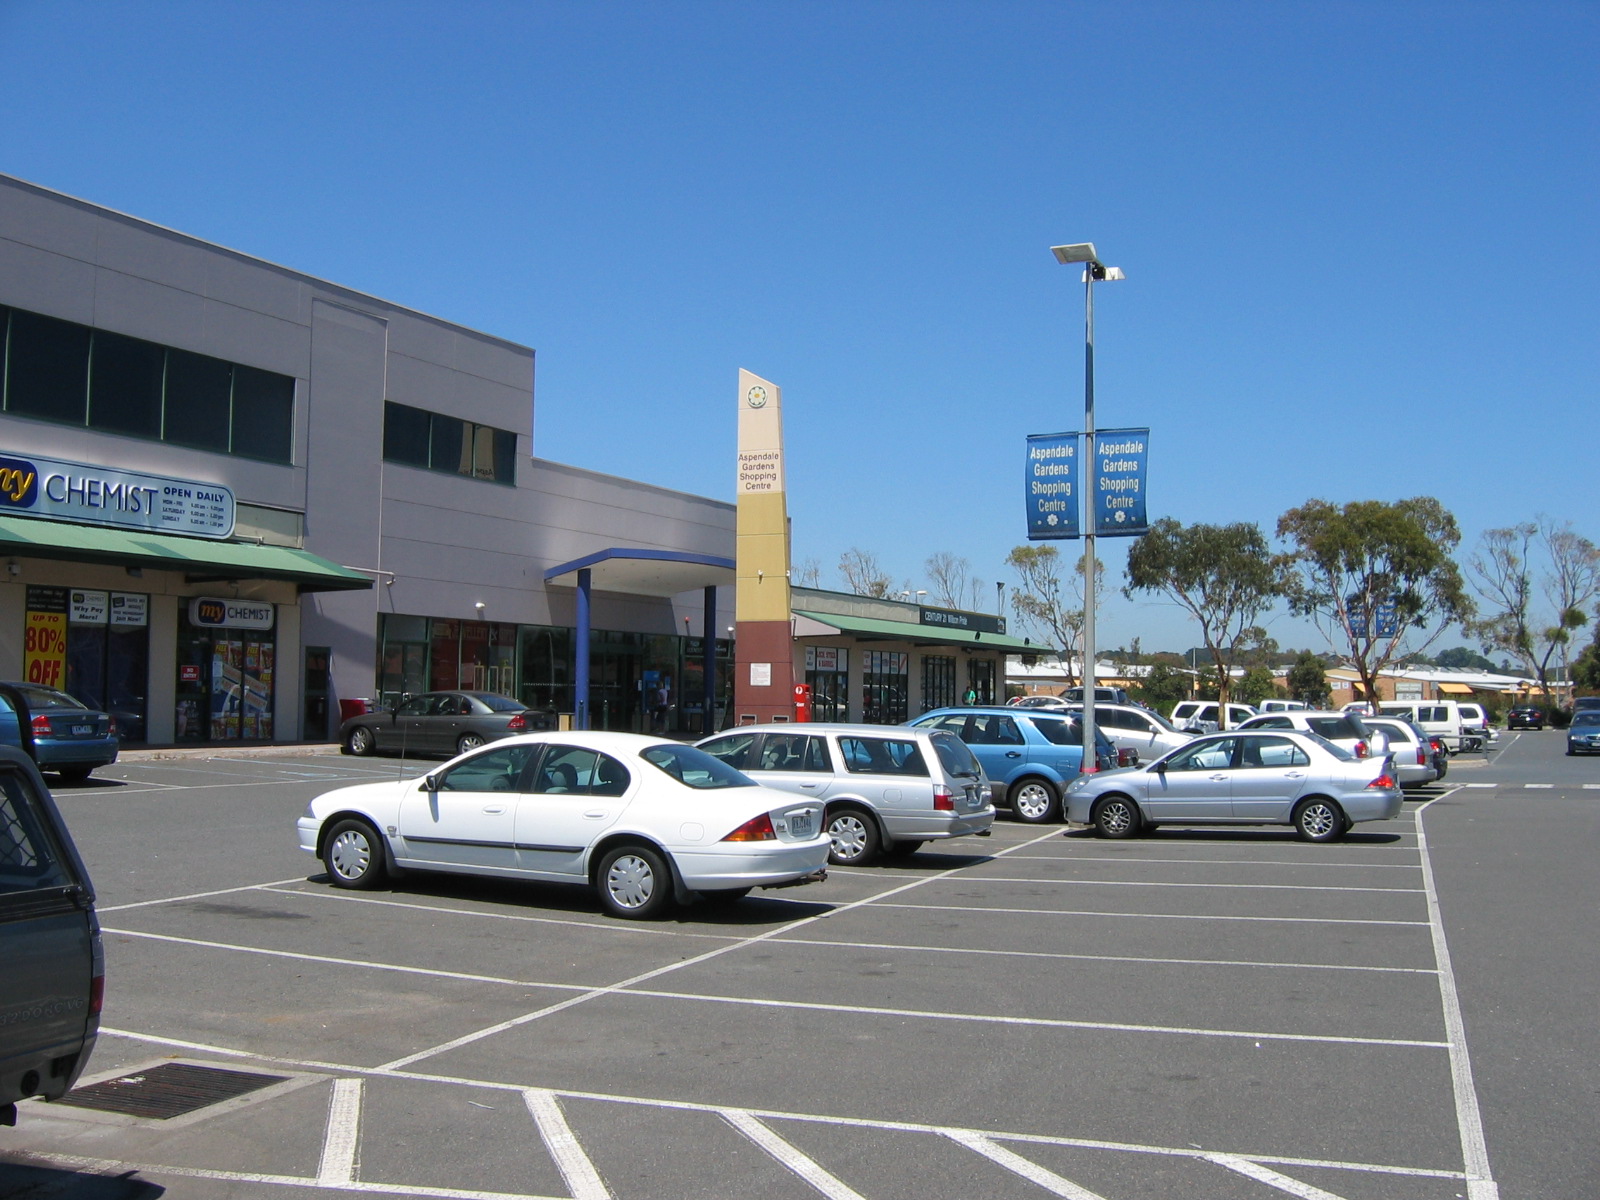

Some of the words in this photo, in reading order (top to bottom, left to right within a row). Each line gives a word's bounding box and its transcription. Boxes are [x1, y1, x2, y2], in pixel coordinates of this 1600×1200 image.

[1030, 444, 1074, 462] Aspendale
[1099, 440, 1143, 457] Aspendale
[738, 453, 779, 462] Aspendale
[742, 463, 775, 471] Gardens
[1034, 463, 1069, 477] Gardens
[1102, 459, 1138, 473] Gardens
[740, 472, 777, 481] Shopping
[745, 482, 771, 490] Centre
[1031, 480, 1071, 497] Shopping
[1100, 476, 1139, 493] Shopping
[44, 474, 159, 515] CHEMIST
[163, 486, 192, 499] OPEN
[196, 491, 225, 503] DAILY
[1038, 499, 1066, 512] Centre
[1106, 495, 1134, 509] Centre
[48, 615, 59, 623] TO
[201, 605, 225, 622] my
[227, 607, 271, 620] CHEMIST
[924, 611, 942, 622] CENTURY
[26, 626, 65, 654] 80%
[29, 659, 61, 687] OFF
